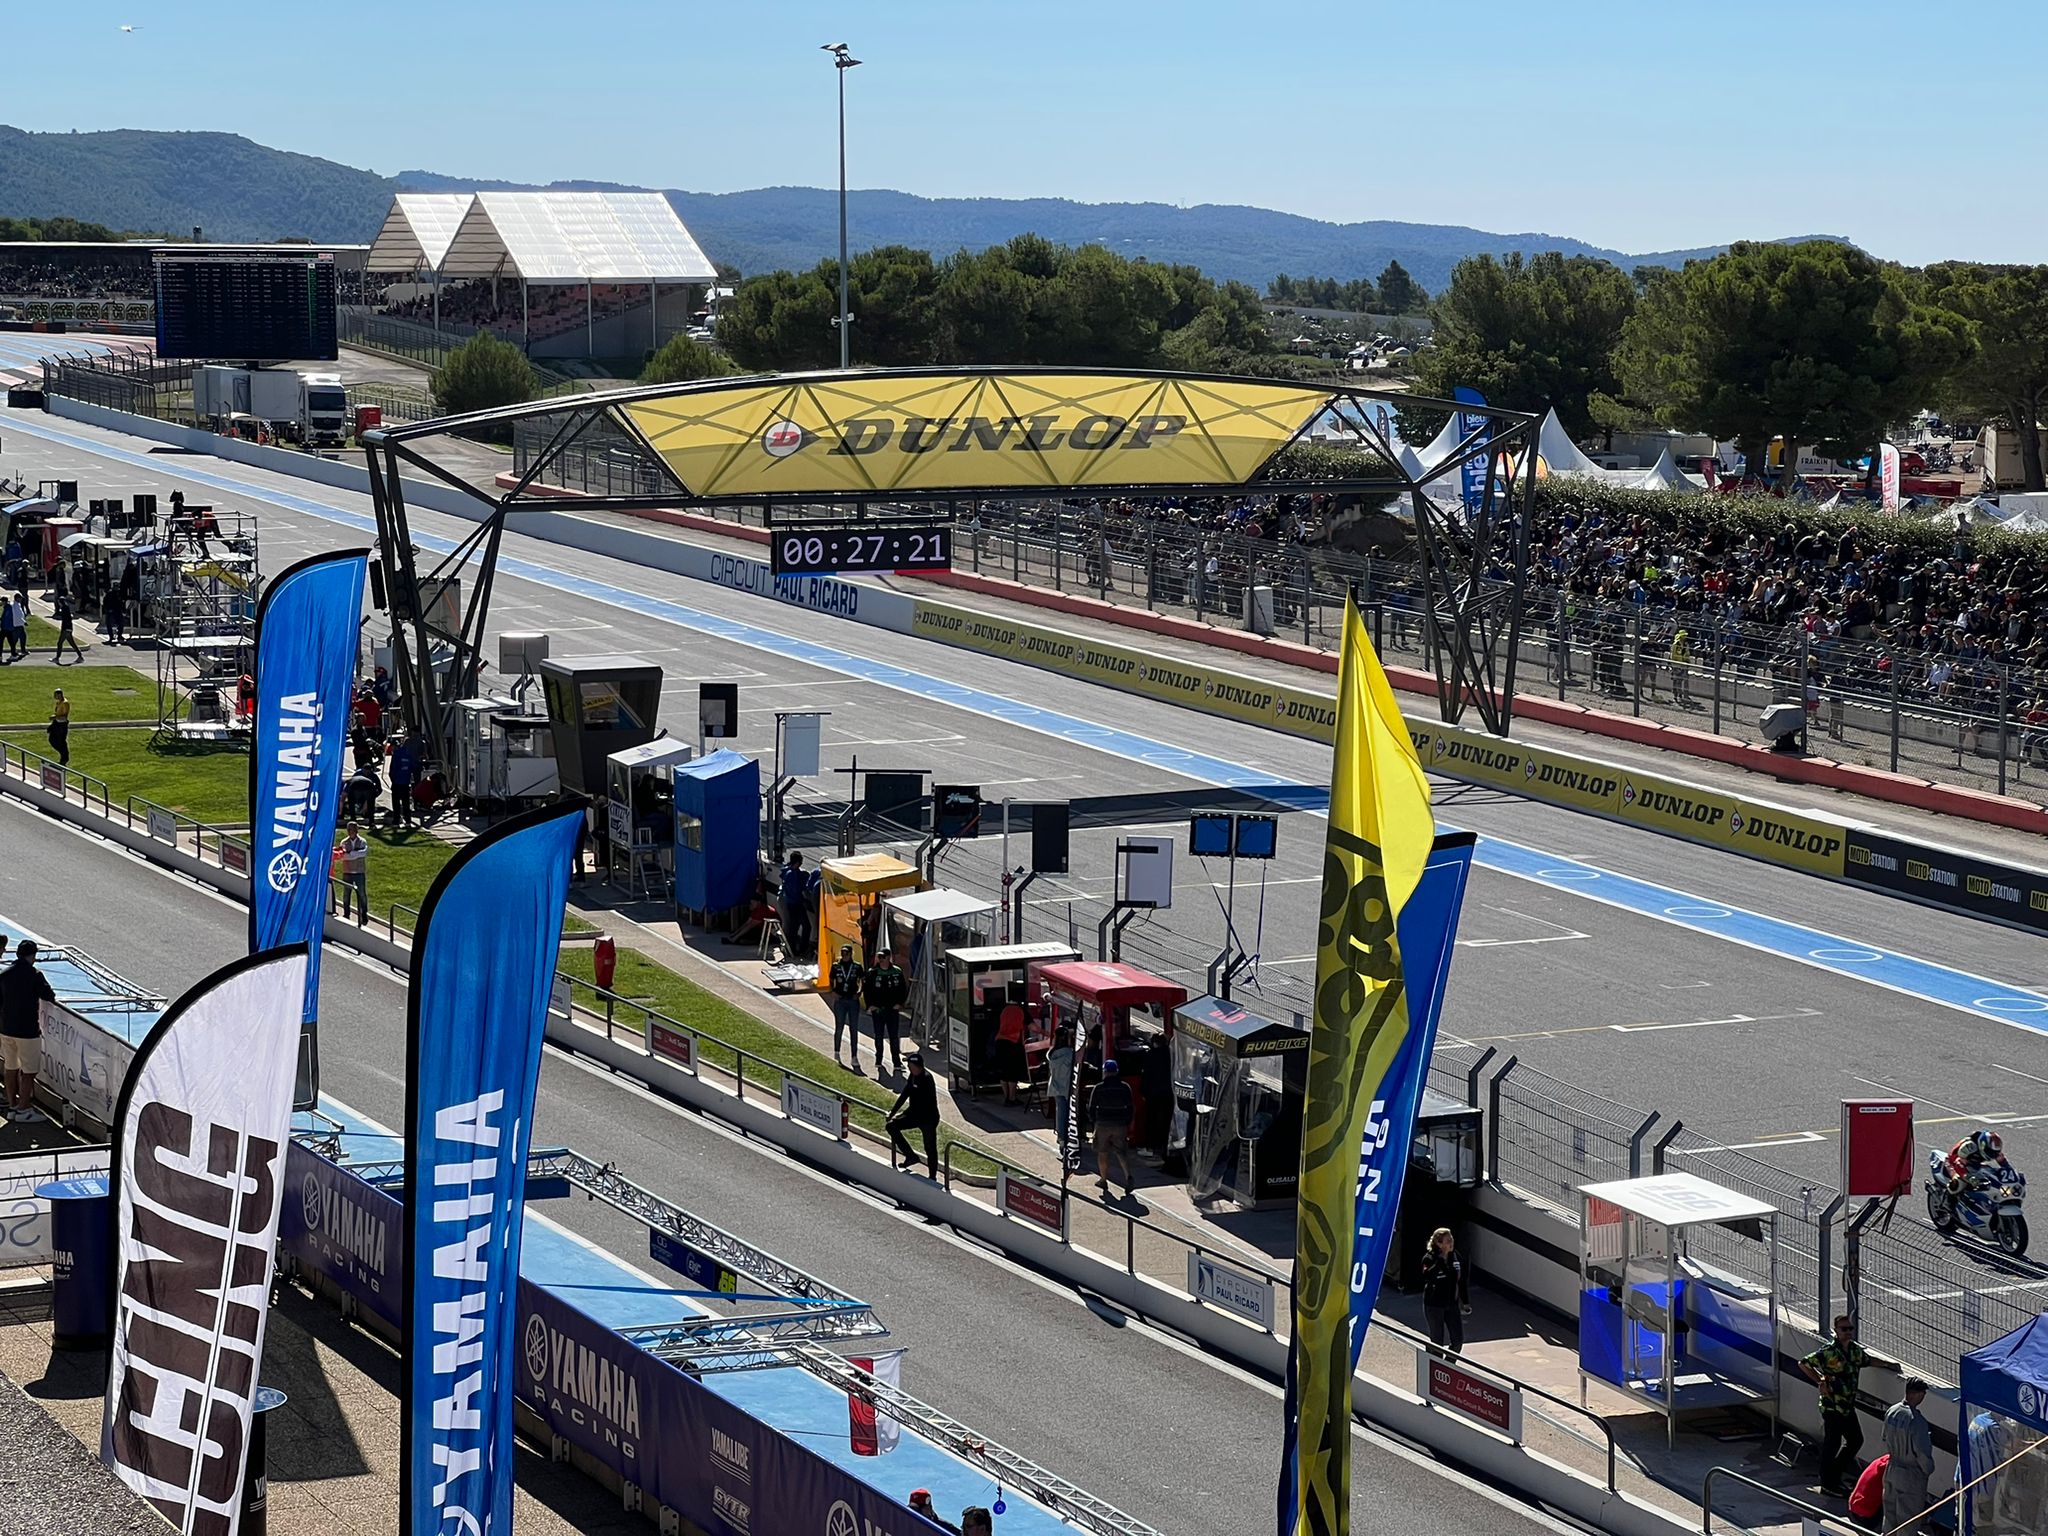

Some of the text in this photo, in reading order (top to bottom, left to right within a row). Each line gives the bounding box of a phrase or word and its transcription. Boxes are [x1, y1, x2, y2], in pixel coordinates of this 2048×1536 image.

[827, 415, 1187, 456] DUNLOP
[783, 534, 946, 565] 00:27:21
[711, 554, 858, 615] CIRCUIT PAUL RICARD
[921, 611, 963, 631] DUNLOP
[972, 623, 1016, 645] DUNLOP
[1027, 637, 1074, 659] DUNLOP
[1085, 651, 1135, 674] DUNLOP
[1148, 668, 1200, 692] DUNLOP
[1214, 684, 1271, 709] DUNLOP
[1287, 701, 1336, 727] DUNLO
[272, 691, 318, 848] YAMAHA
[1448, 741, 1520, 773] DUNLOP
[1538, 764, 1617, 797] DUNLOP
[1638, 789, 1724, 825] DUNLOP
[1745, 817, 1841, 857] DUNLOP
[2001, 1170, 2015, 1183] 24
[322, 1183, 386, 1277] YAMAHA
[309, 1233, 380, 1293] RACING
[432, 1089, 504, 1507] YAMAHA
[1216, 1274, 1260, 1299] CIRCUIT
[1216, 1287, 1259, 1313] PAUL RICARD
[551, 1328, 640, 1440] YAMAHA
[1465, 1383, 1503, 1407] Audi Sport
[534, 1385, 635, 1459] RACING
[711, 1427, 750, 1470] YAMALUBE
